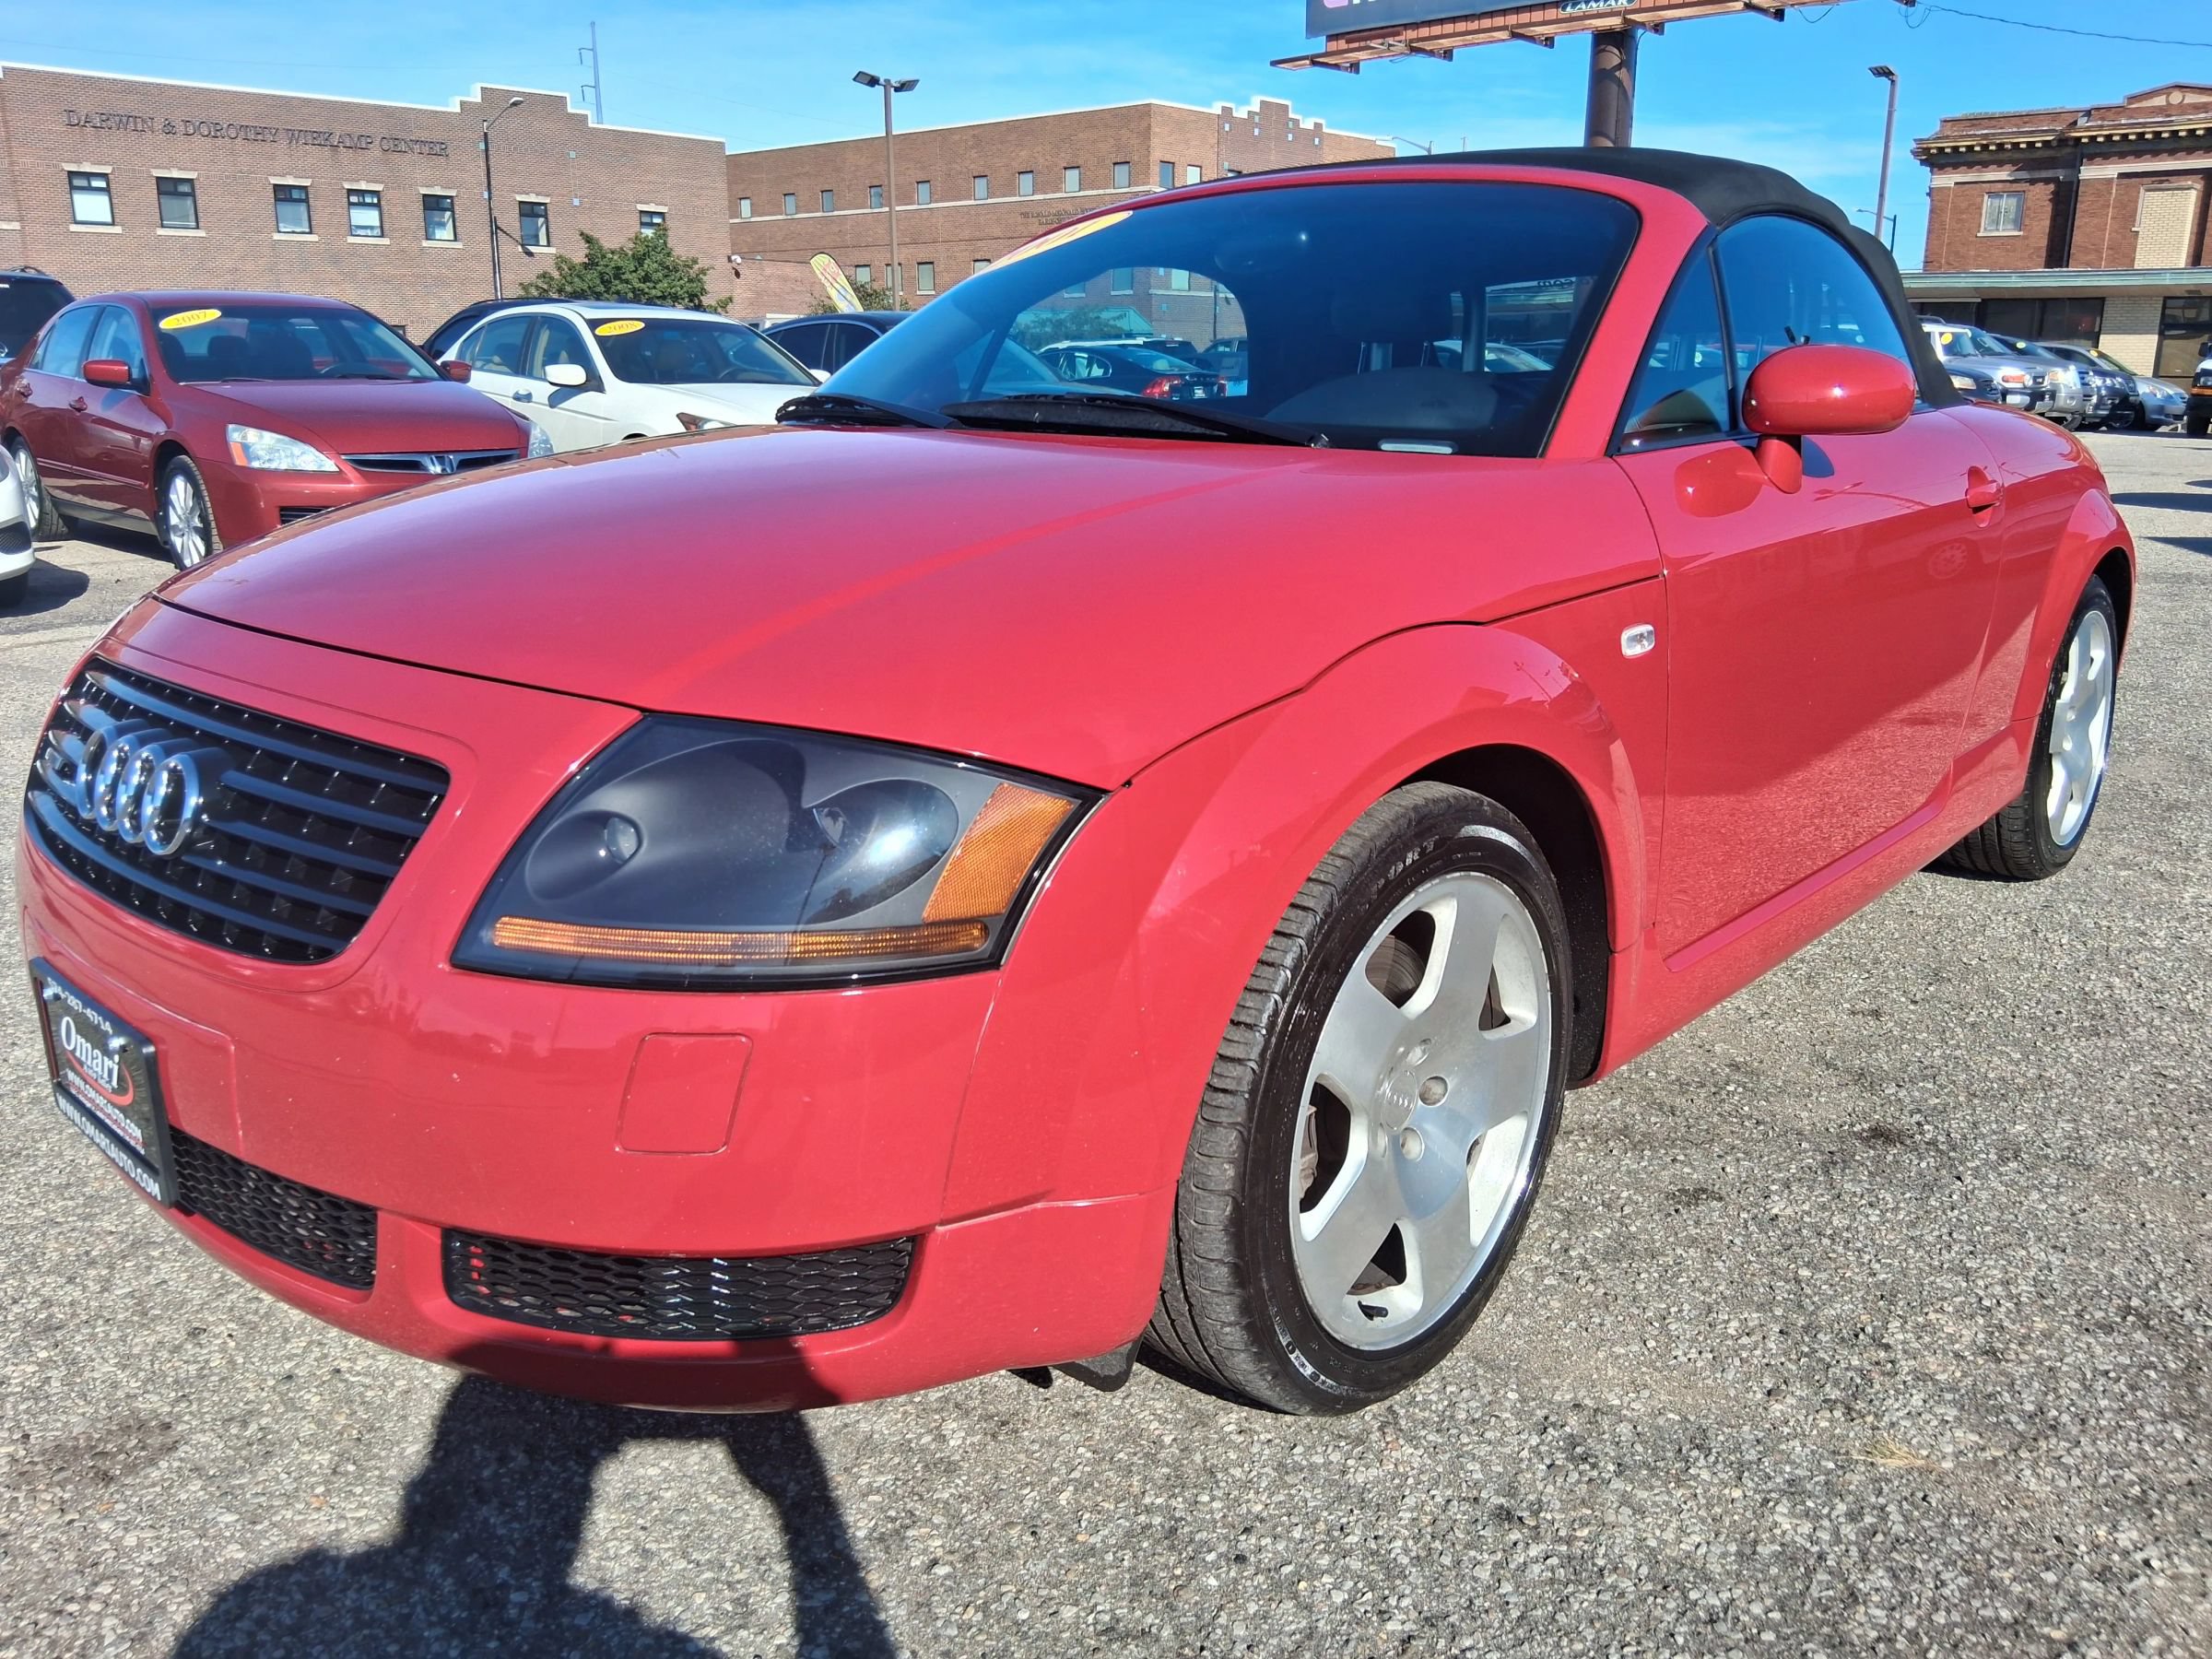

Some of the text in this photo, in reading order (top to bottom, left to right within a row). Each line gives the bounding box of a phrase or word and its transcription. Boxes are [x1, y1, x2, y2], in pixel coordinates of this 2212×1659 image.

[64, 109, 450, 158] DARWIN & DOROTHY WIEKAMP CENTER
[174, 311, 207, 325] 2007
[607, 322, 639, 334] 2008
[61, 1017, 119, 1089] Omari
[55, 1092, 161, 1201] WWW.OMARIAUTO.COM
